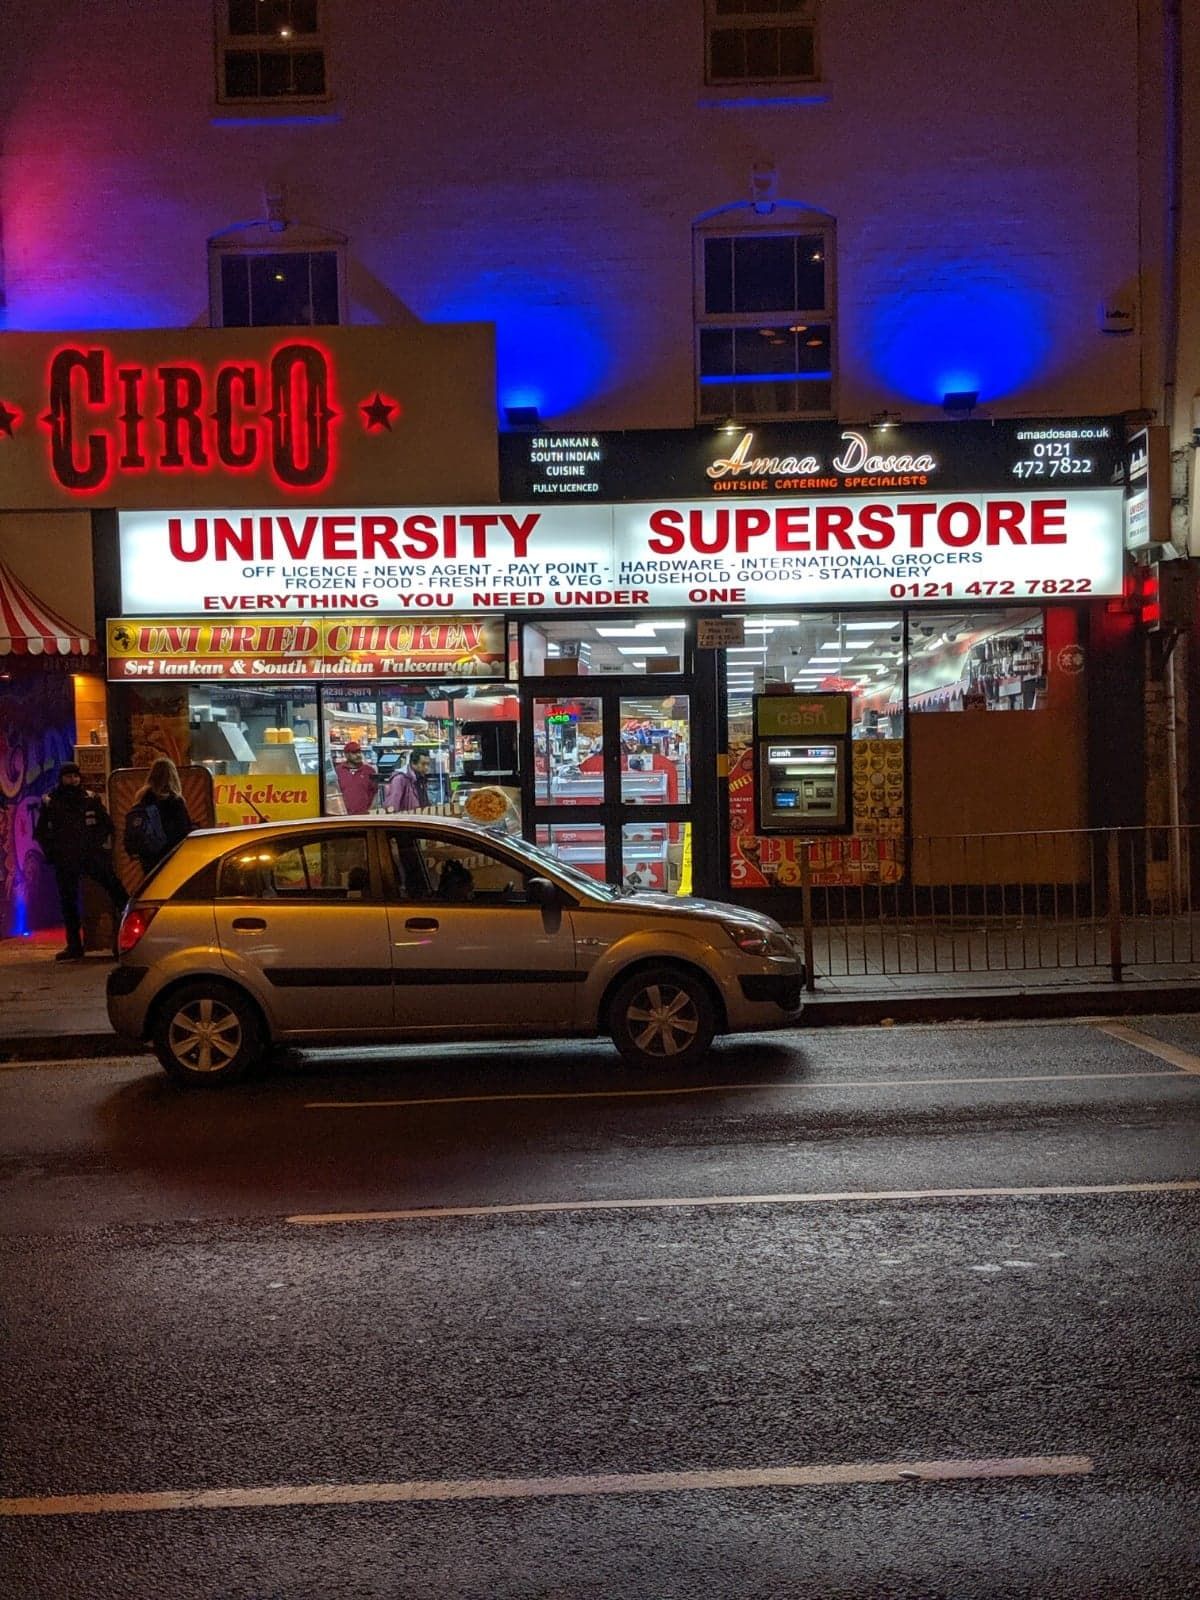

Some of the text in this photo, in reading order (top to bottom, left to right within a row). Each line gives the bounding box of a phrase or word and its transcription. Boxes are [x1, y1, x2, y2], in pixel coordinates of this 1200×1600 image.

[46, 344, 338, 489] CIRCO
[532, 438, 599, 449] SRI LANKAN &
[1017, 428, 1109, 440] amaadosaa.co.uk
[531, 451, 600, 462] SOUTH INDIAN
[706, 431, 936, 478] Amaa Dosaa
[1033, 443, 1071, 457] 0121
[546, 466, 585, 476] CUISINE
[1012, 461, 1044, 478] 472
[1048, 457, 1093, 478] 7822
[533, 484, 599, 493] FULLY LICENCED
[714, 476, 927, 491] OUTSIDE CATERING SPECIALISTS
[168, 499, 1067, 562] UNIVERSITY SUPERSTORE
[242, 566, 276, 578] OFF
[282, 565, 358, 577] LICENCE
[374, 564, 426, 576] NEWS
[431, 563, 491, 575] AGENT
[508, 563, 541, 575] PAY
[546, 562, 599, 574] POINT
[621, 559, 724, 572] HARDWARE
[741, 555, 886, 568] INTERNATIONAL
[892, 552, 983, 565] GROCERS
[285, 577, 356, 590] FROZEN
[362, 577, 412, 589] FOOD
[429, 576, 487, 588] FRESH
[491, 575, 544, 587] FRUIT
[549, 575, 561, 587] &
[567, 574, 602, 586] VEG
[618, 572, 731, 585] HOUSEHOLD
[737, 569, 803, 582] GOODS
[819, 566, 932, 580] STATIONERY
[204, 578, 1093, 610] EVERYTHING YOU NEED UNDER ONE 0121 472 7822
[137, 622, 484, 655] UNI FRIED CHICKEN
[124, 657, 475, 677] Sri lankan & South Indian Takeaway
[777, 706, 829, 726] cash
[771, 750, 791, 758] cash
[214, 784, 308, 805] Chicken
